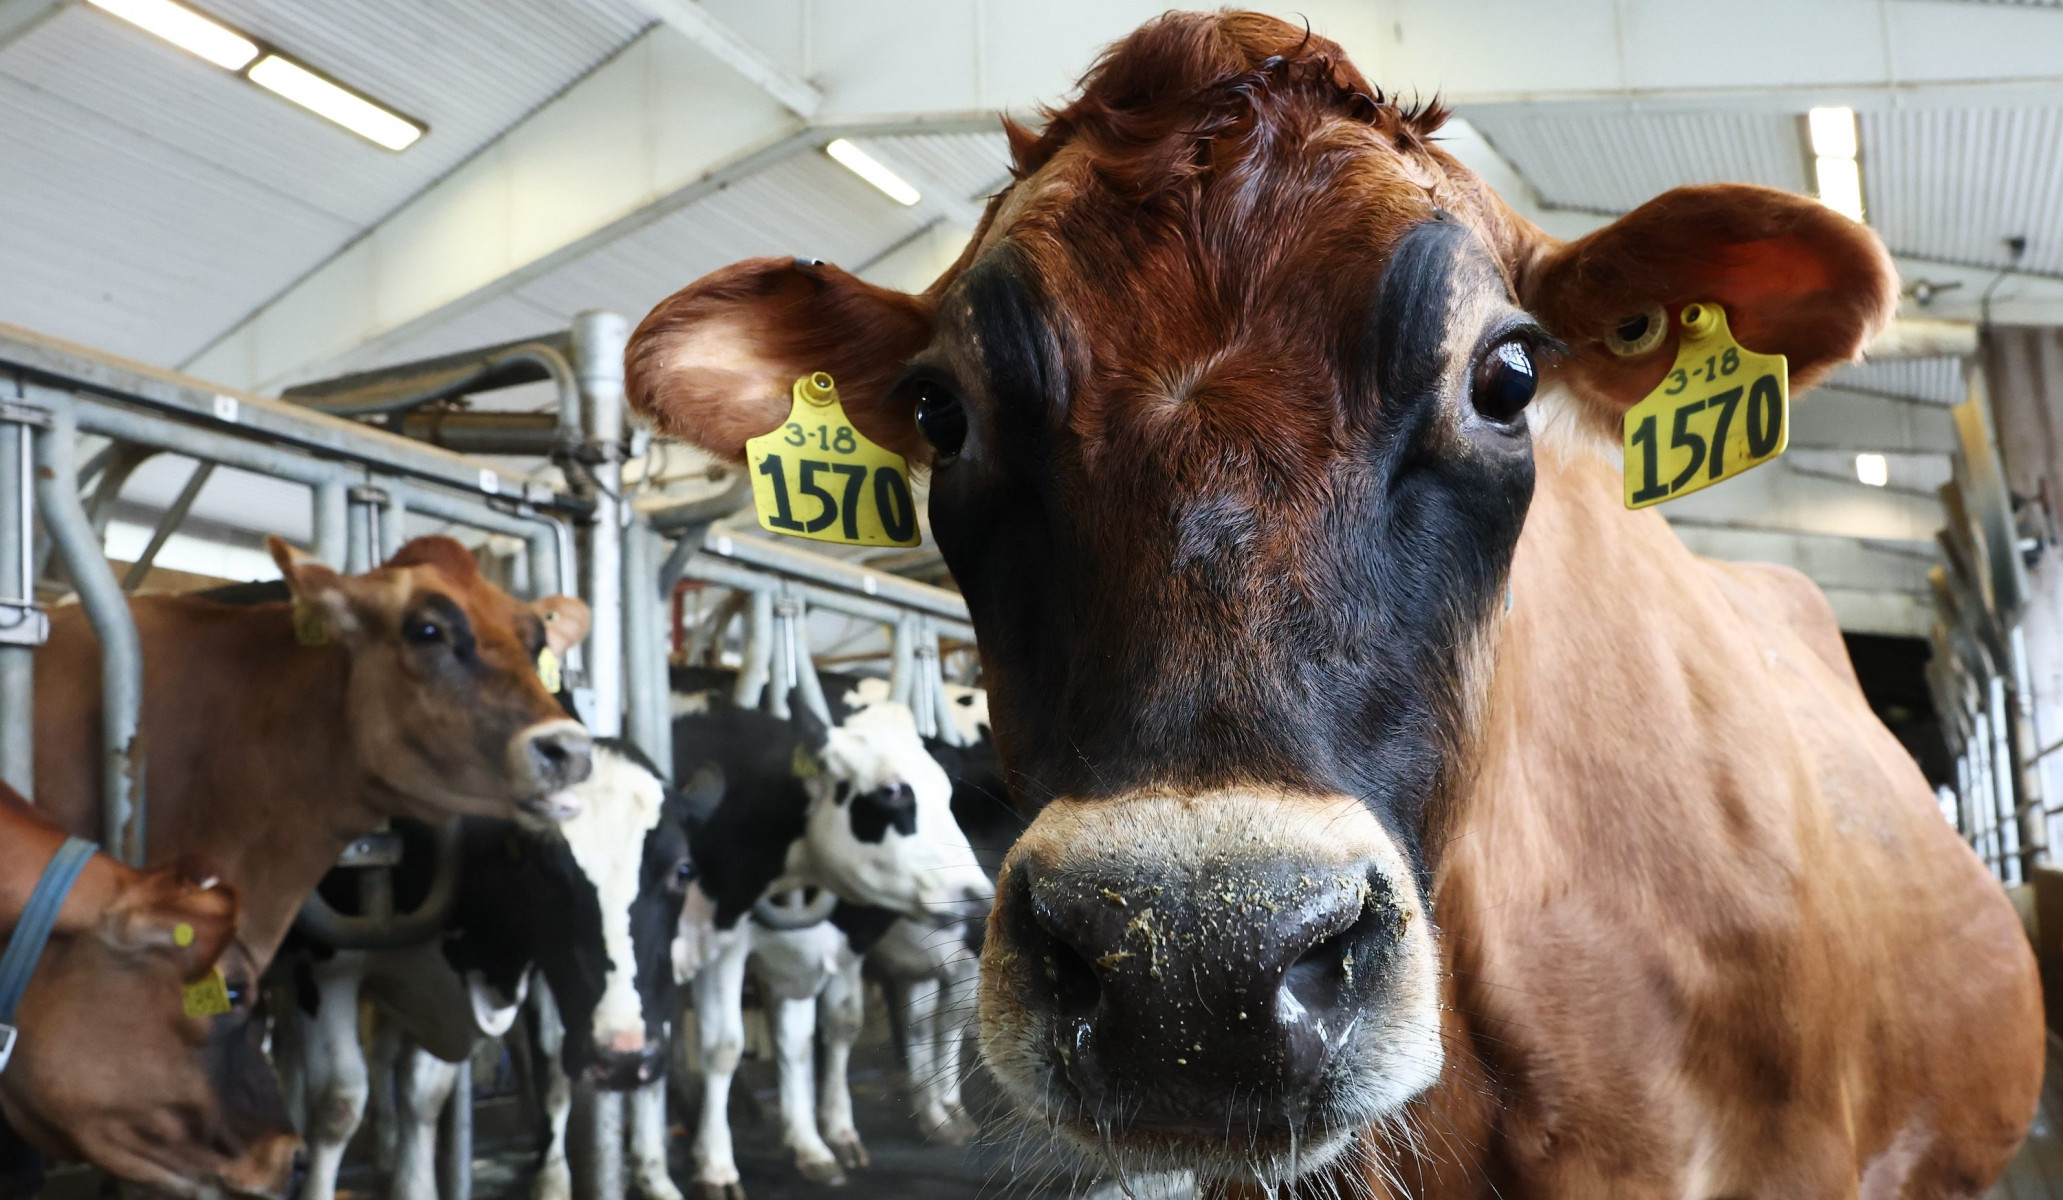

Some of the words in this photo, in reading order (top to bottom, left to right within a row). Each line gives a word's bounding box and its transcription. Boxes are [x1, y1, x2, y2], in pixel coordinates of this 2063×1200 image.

[1664, 346, 1740, 395] 3-18
[783, 422, 857, 454] 3-18
[1631, 374, 1782, 505] 1570
[759, 453, 914, 543] 1570
